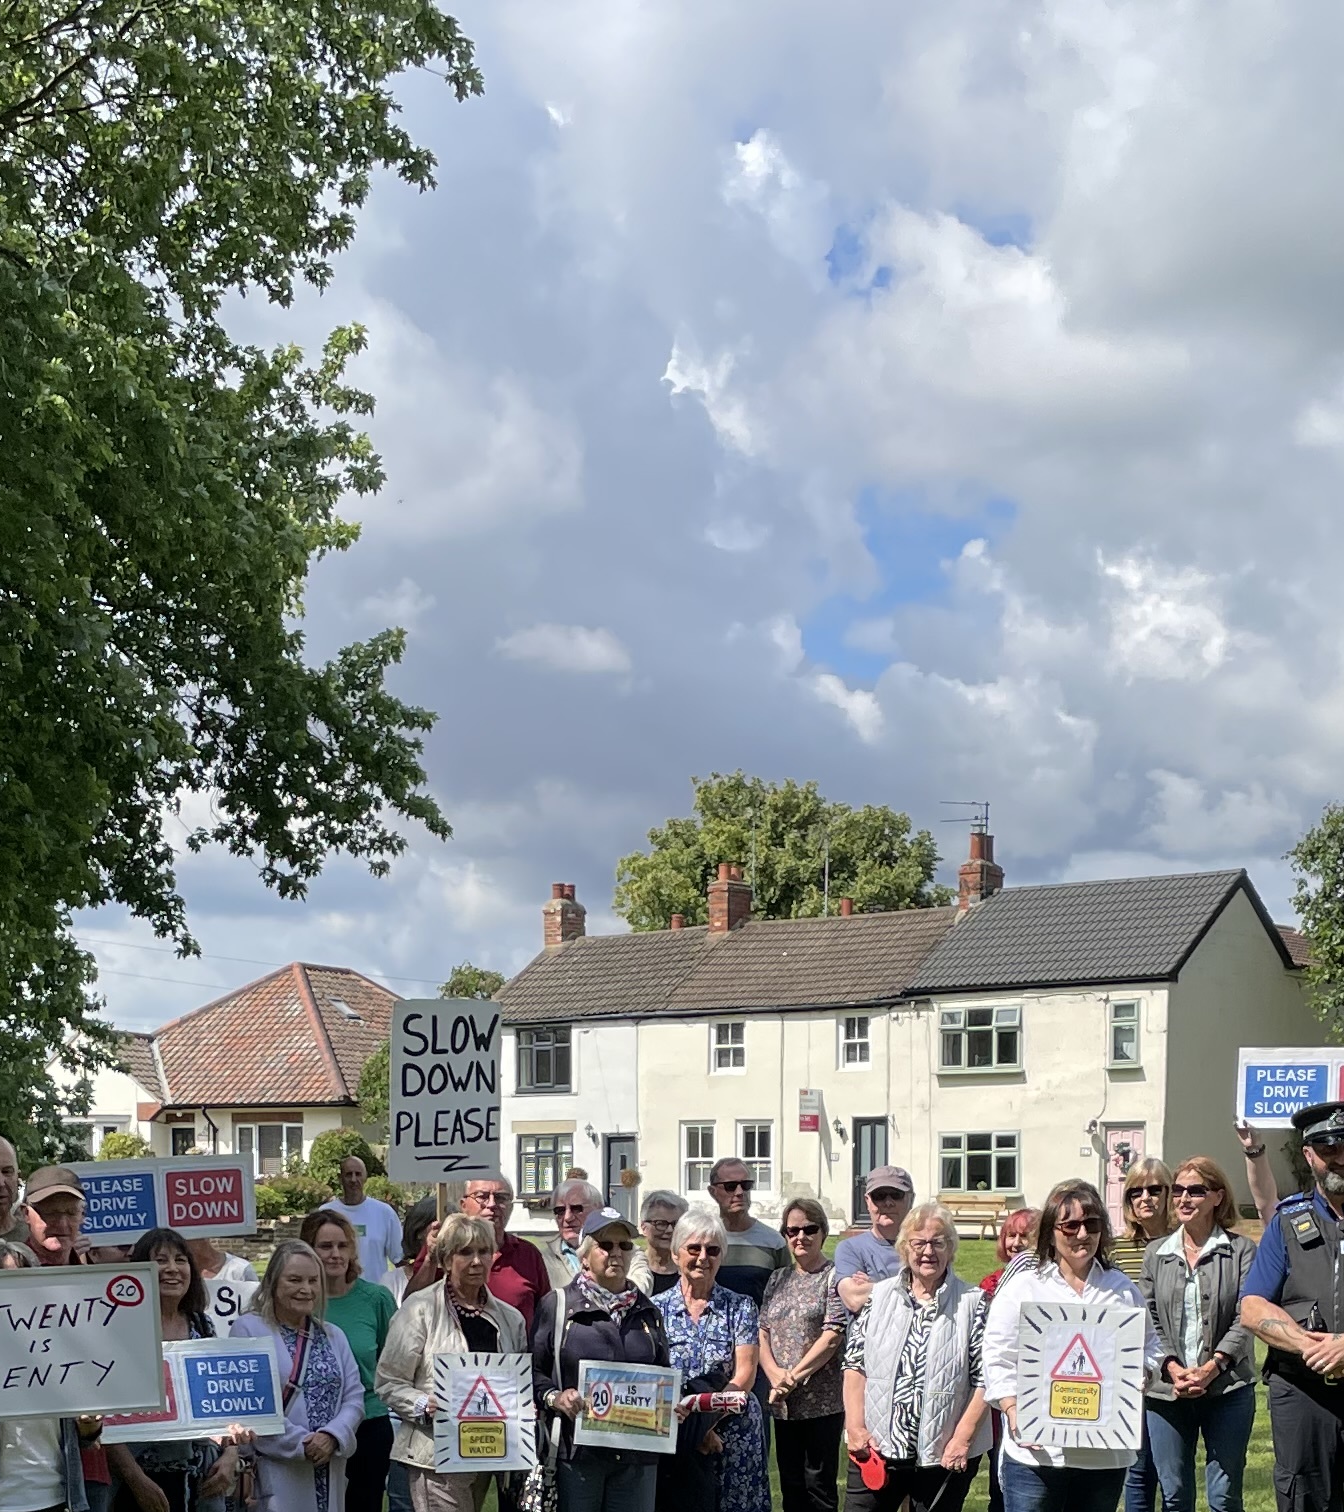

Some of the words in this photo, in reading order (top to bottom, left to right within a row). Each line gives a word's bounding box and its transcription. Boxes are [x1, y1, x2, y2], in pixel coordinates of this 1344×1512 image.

[402, 1013, 499, 1057] SLOW
[401, 1060, 496, 1097] DOWN
[1257, 1069, 1316, 1082] PLEASE
[1263, 1086, 1309, 1098] DRIVE
[1254, 1101, 1317, 1114] SLOWL
[395, 1106, 501, 1148] PLEASE
[82, 1178, 143, 1194] PLEASE
[175, 1176, 234, 1196] SLOW
[90, 1196, 137, 1211] DRIVE
[173, 1200, 239, 1220] DOWN
[83, 1213, 147, 1229] SLOWLY
[116, 1284, 136, 1297] 20
[30, 1339, 50, 1354] IS
[197, 1359, 259, 1376] PLEASE
[207, 1379, 254, 1394] DRIVE
[628, 1385, 637, 1395] IS
[1054, 1384, 1097, 1397] Community
[201, 1397, 265, 1413] SLOWLY
[593, 1390, 609, 1407] 20
[615, 1395, 651, 1407] PLENTY
[1062, 1396, 1089, 1405] SPEED
[1060, 1406, 1089, 1415] WATCH
[461, 1425, 503, 1435] Community
[470, 1436, 496, 1444] SPEED
[469, 1446, 496, 1454] WATCH
